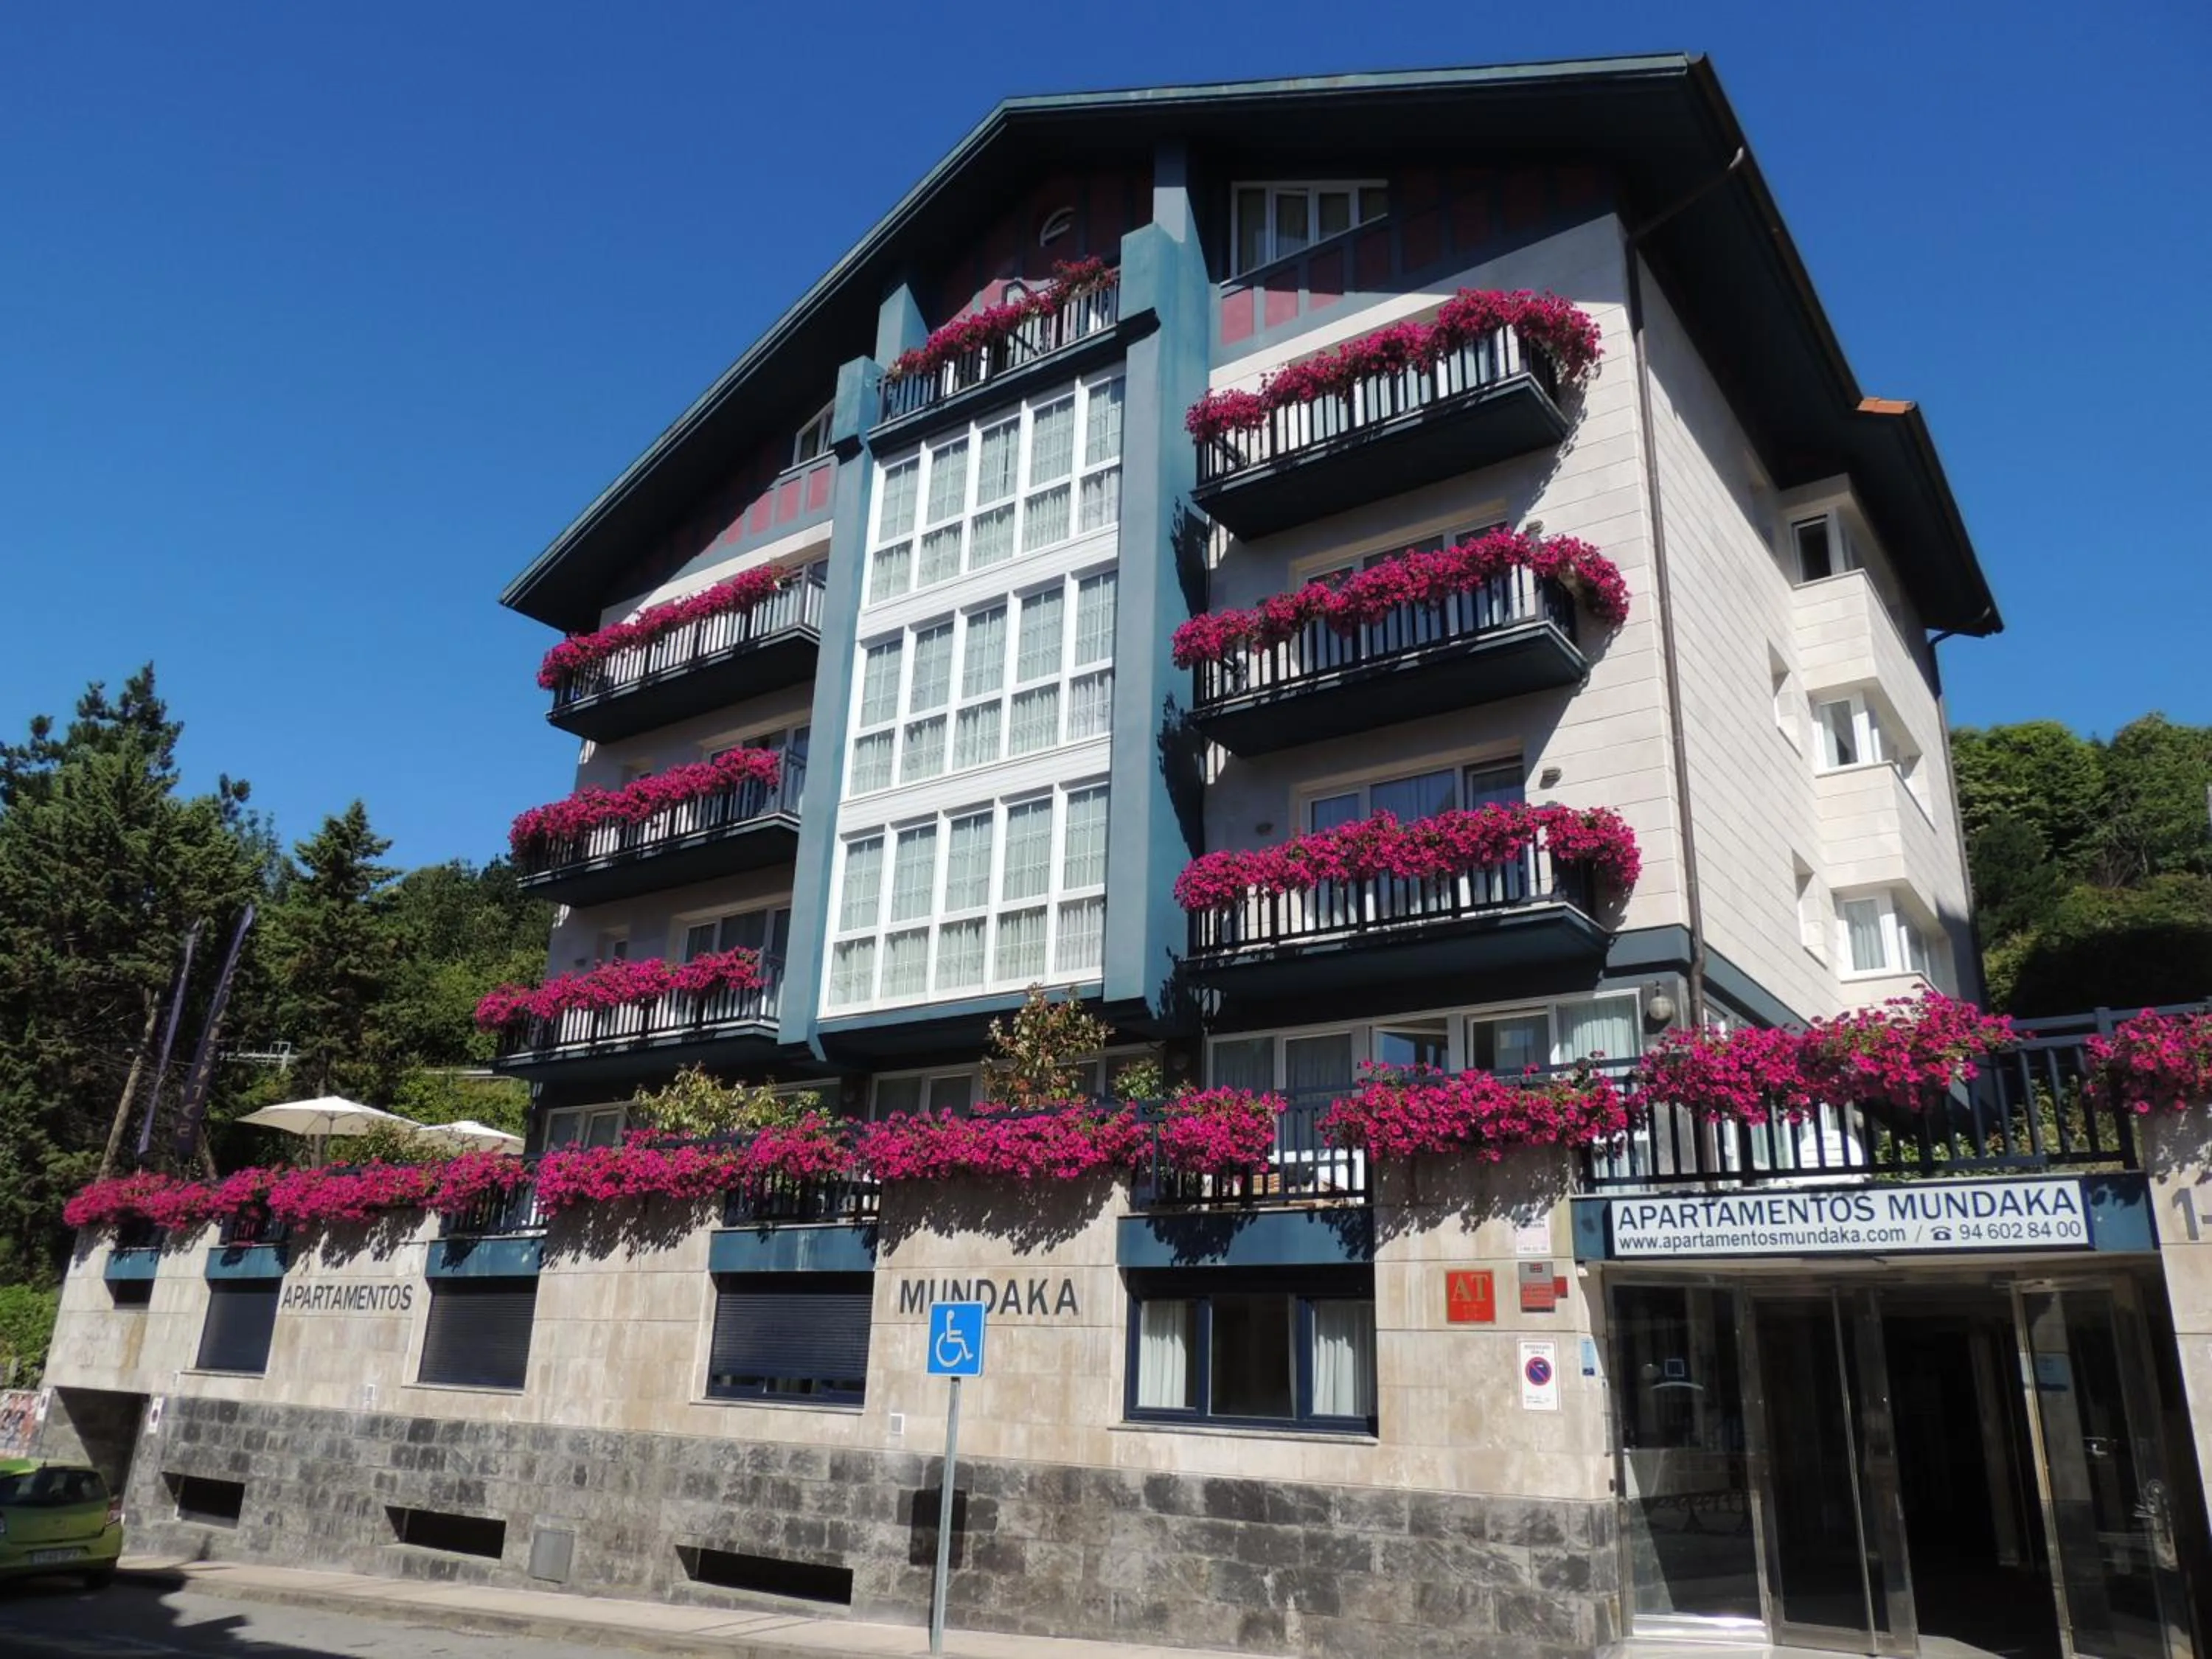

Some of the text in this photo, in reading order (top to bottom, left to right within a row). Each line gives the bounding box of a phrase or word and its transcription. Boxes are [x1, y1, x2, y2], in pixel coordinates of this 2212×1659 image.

[1618, 1188, 2077, 1230] APARTAMENTOS MUNDAKA
[1618, 1226, 1906, 1252] www.apartamentosmundaka.com
[1959, 1224, 1983, 1239] 94
[1987, 1222, 2023, 1239] 602
[2028, 1222, 2052, 1238] 84
[2056, 1220, 2081, 1237] 00
[282, 1284, 413, 1310] APARTAMENTOS
[1450, 1273, 1488, 1302] AT
